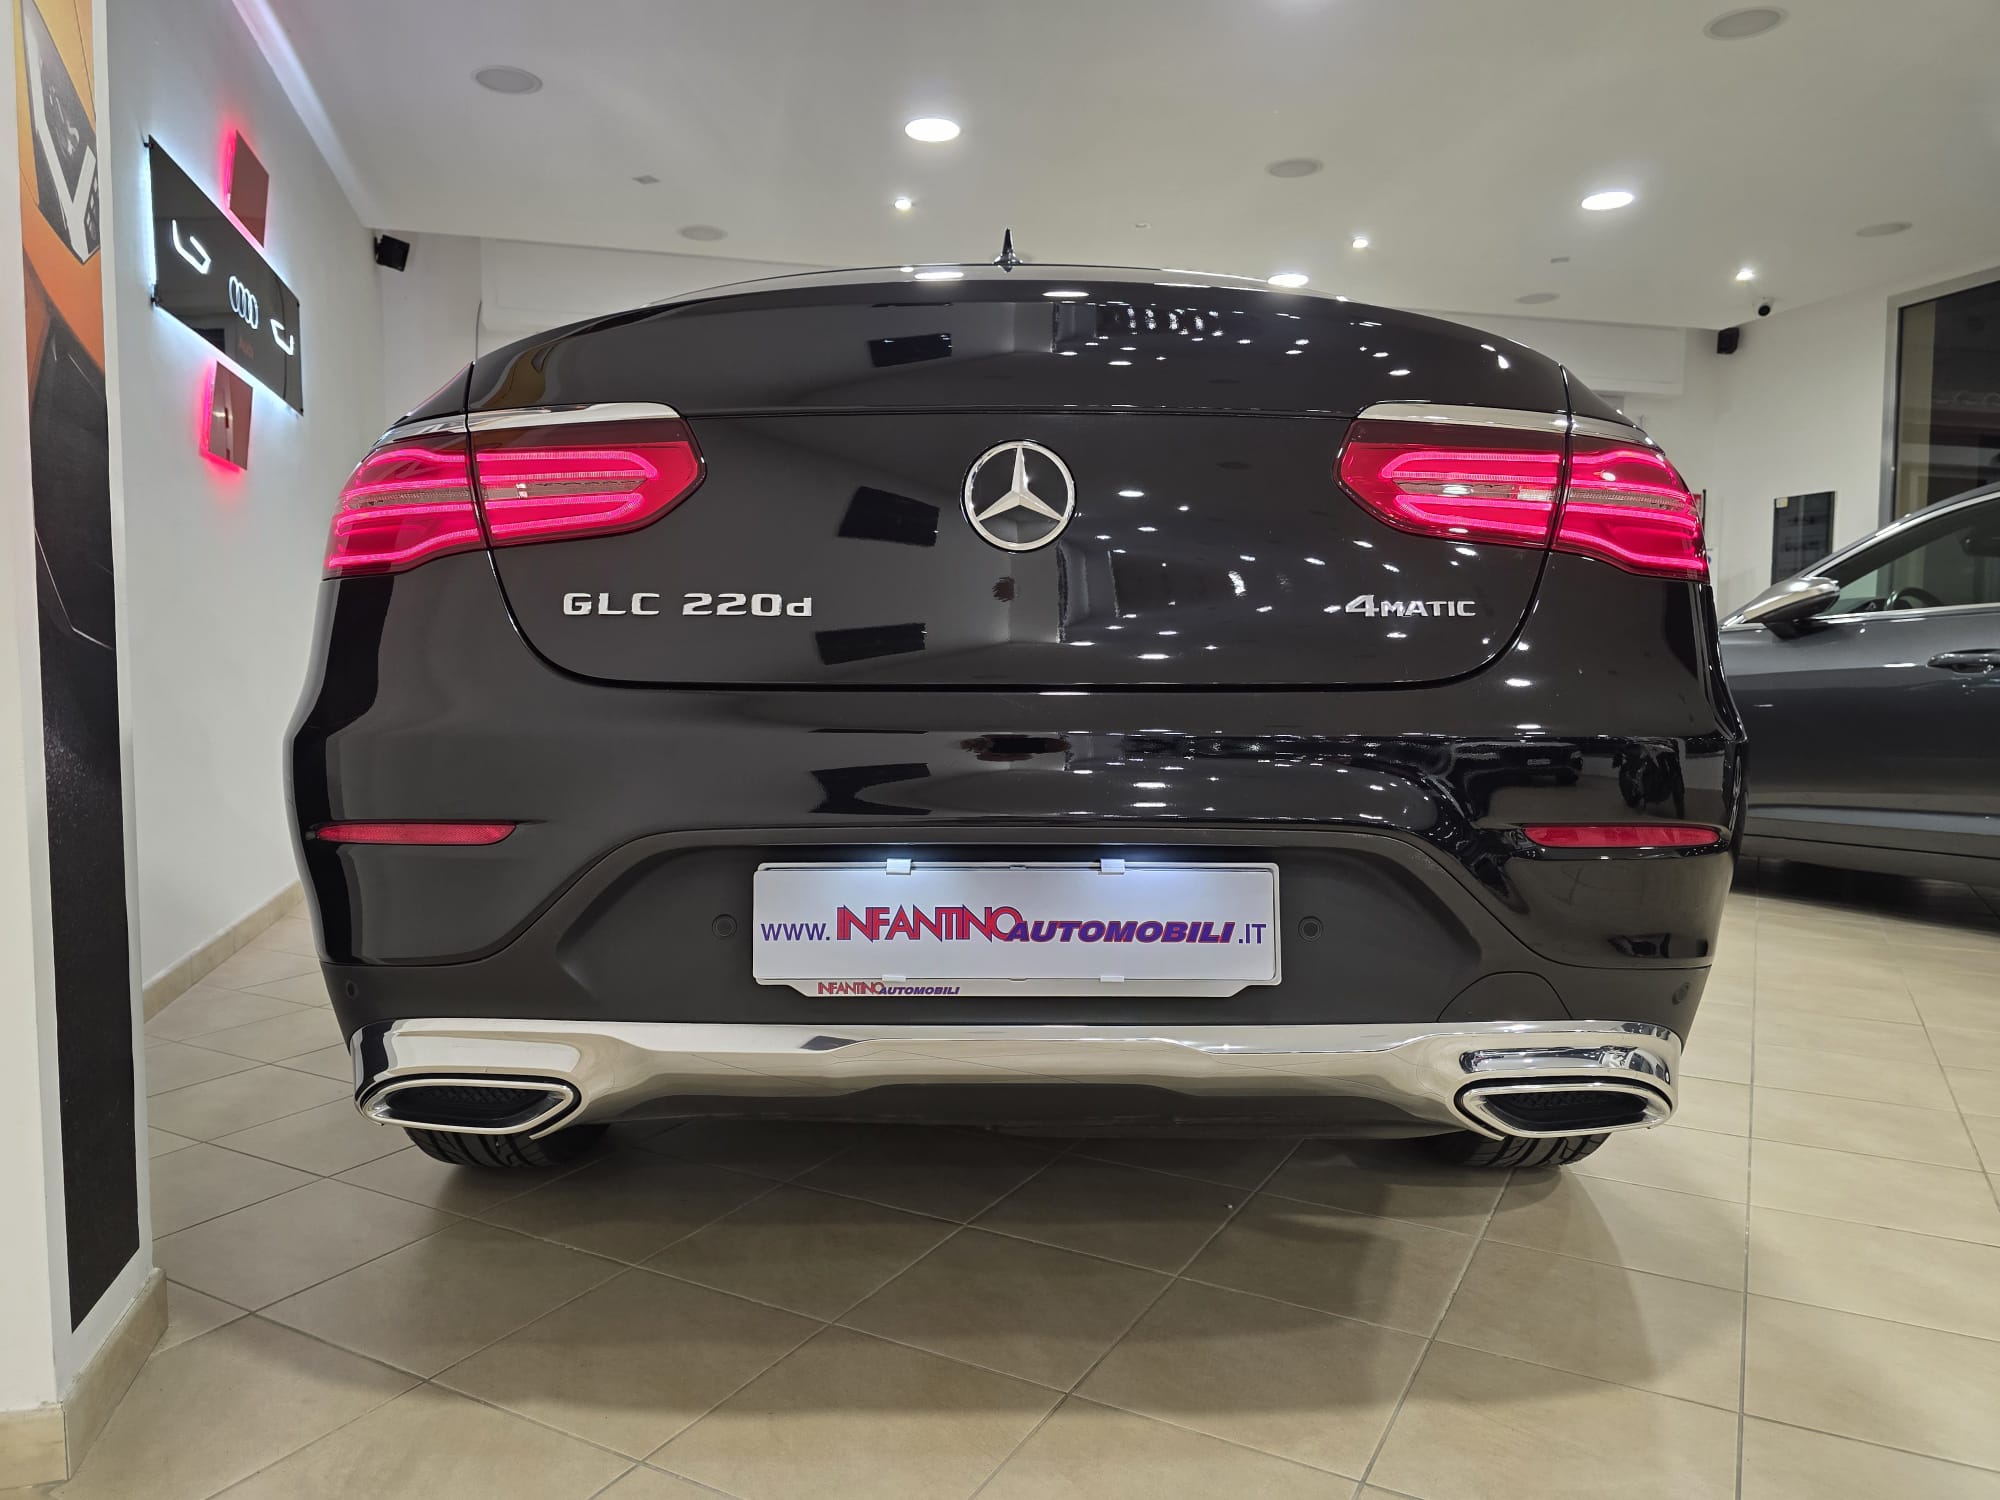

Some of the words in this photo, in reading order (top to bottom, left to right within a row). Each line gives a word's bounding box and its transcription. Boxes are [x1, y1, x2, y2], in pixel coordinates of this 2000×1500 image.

[563, 593, 660, 615] GLC
[682, 593, 812, 617] 220d
[1345, 594, 1476, 617] 4MATIC
